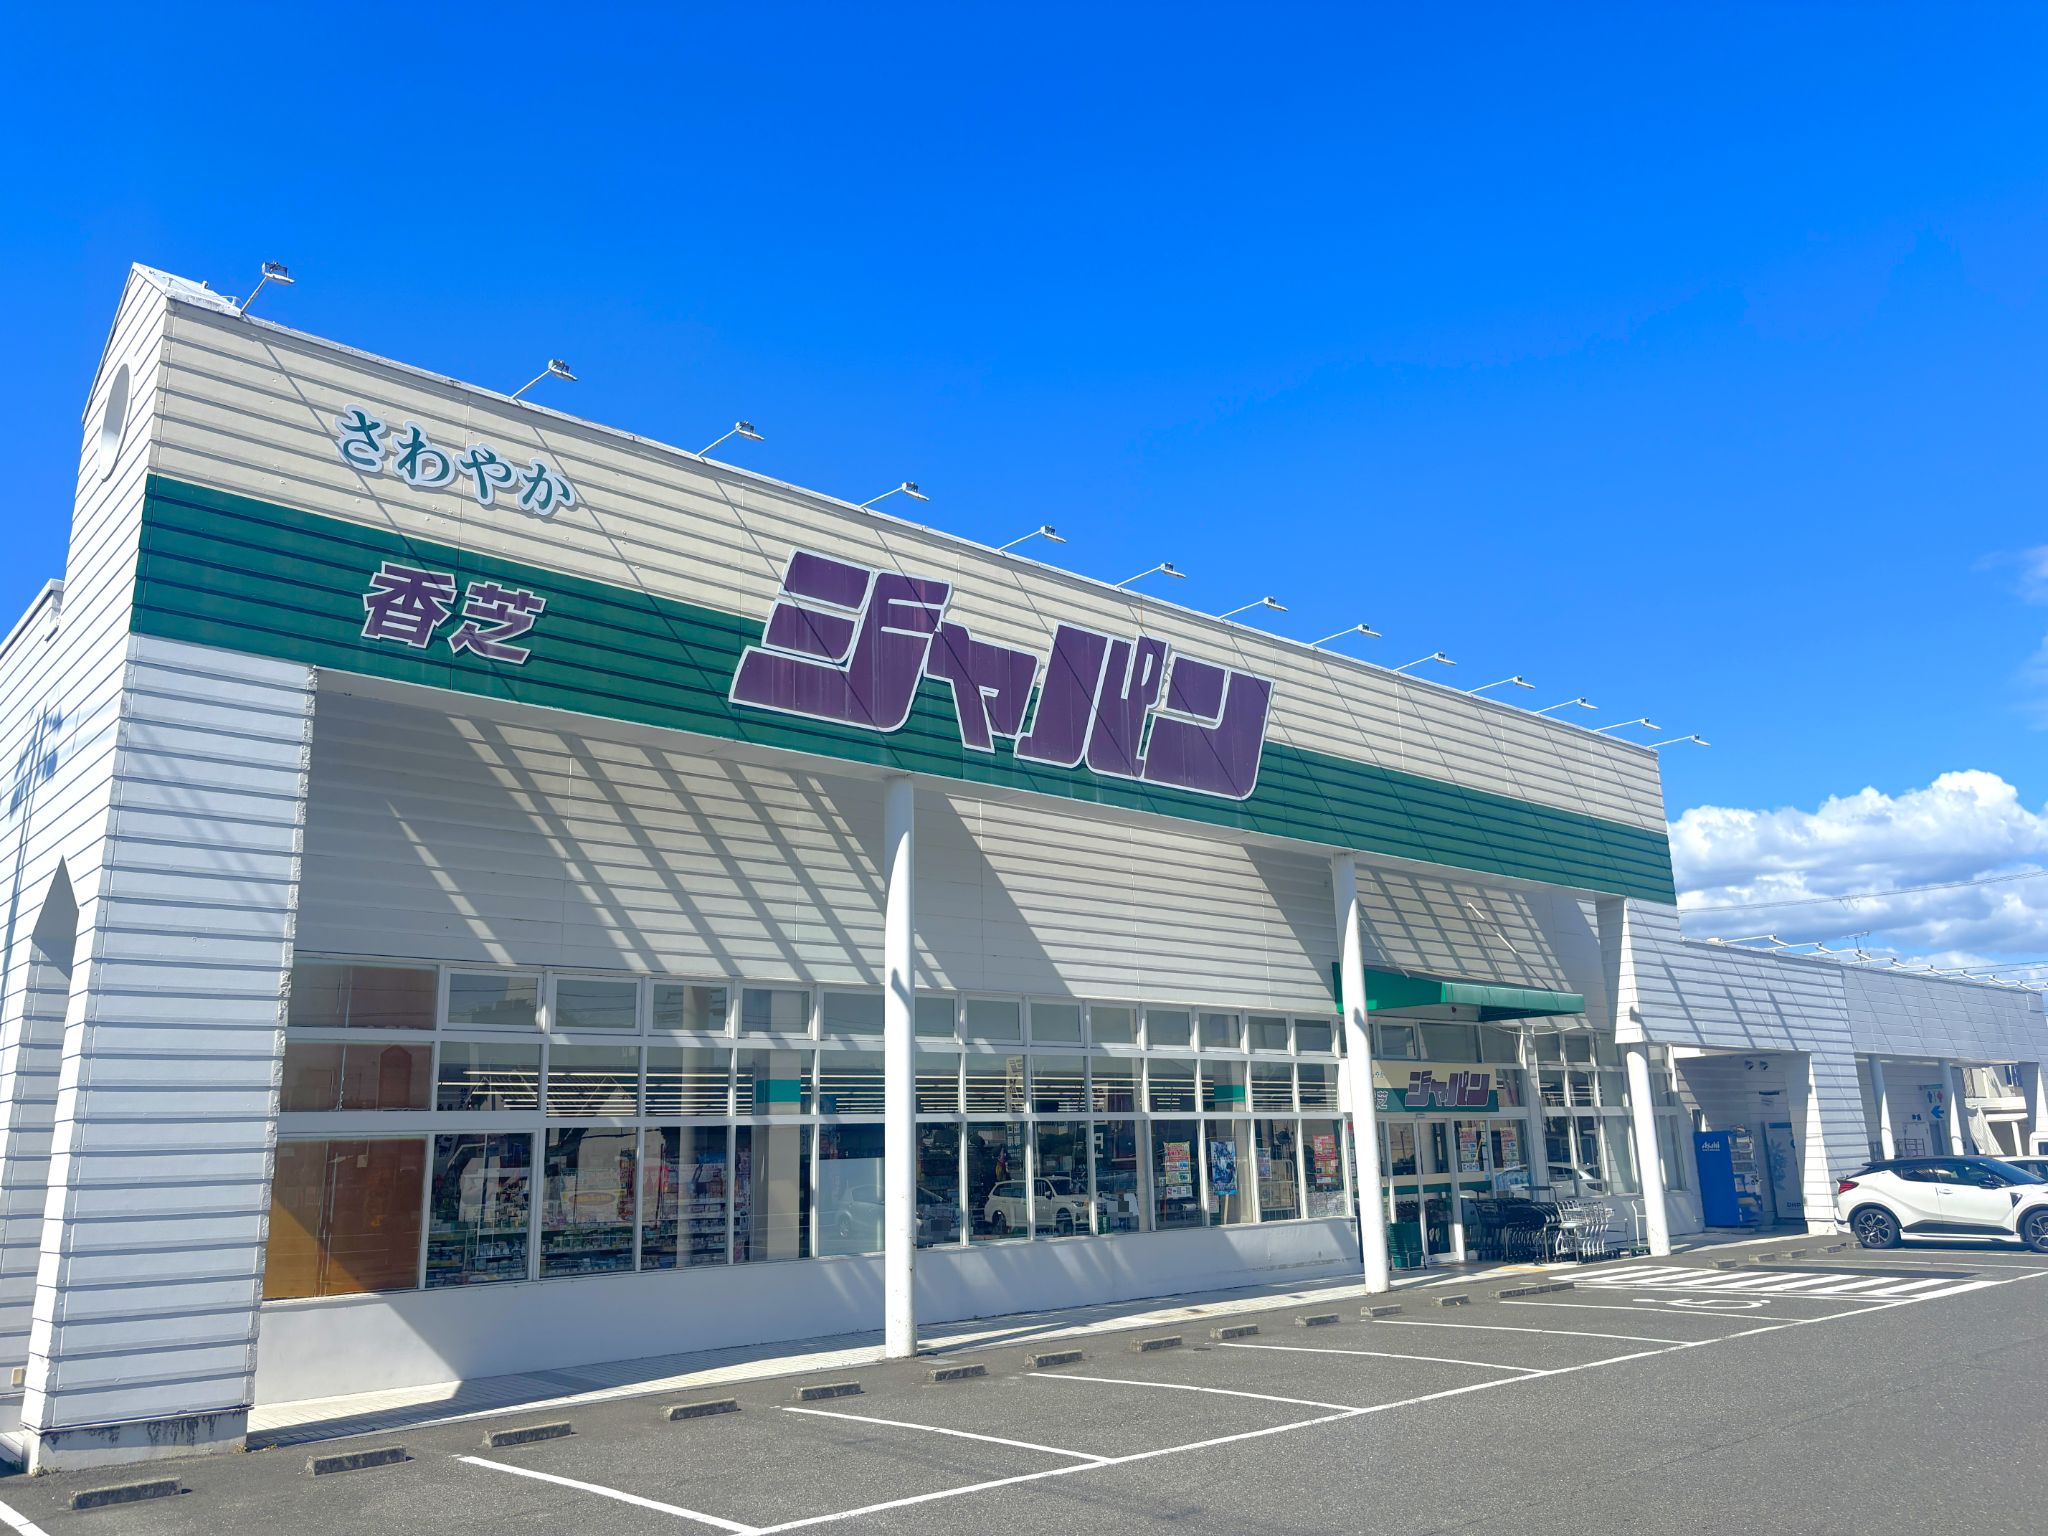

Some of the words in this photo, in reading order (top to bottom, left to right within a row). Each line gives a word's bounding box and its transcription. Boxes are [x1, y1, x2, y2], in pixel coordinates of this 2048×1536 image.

[336, 405, 575, 514] さわやか
[361, 561, 546, 664] 香芝
[729, 547, 1275, 801] ジャパン
[1374, 1090, 1388, 1110] 芝
[1405, 1071, 1490, 1107] ジャパン
